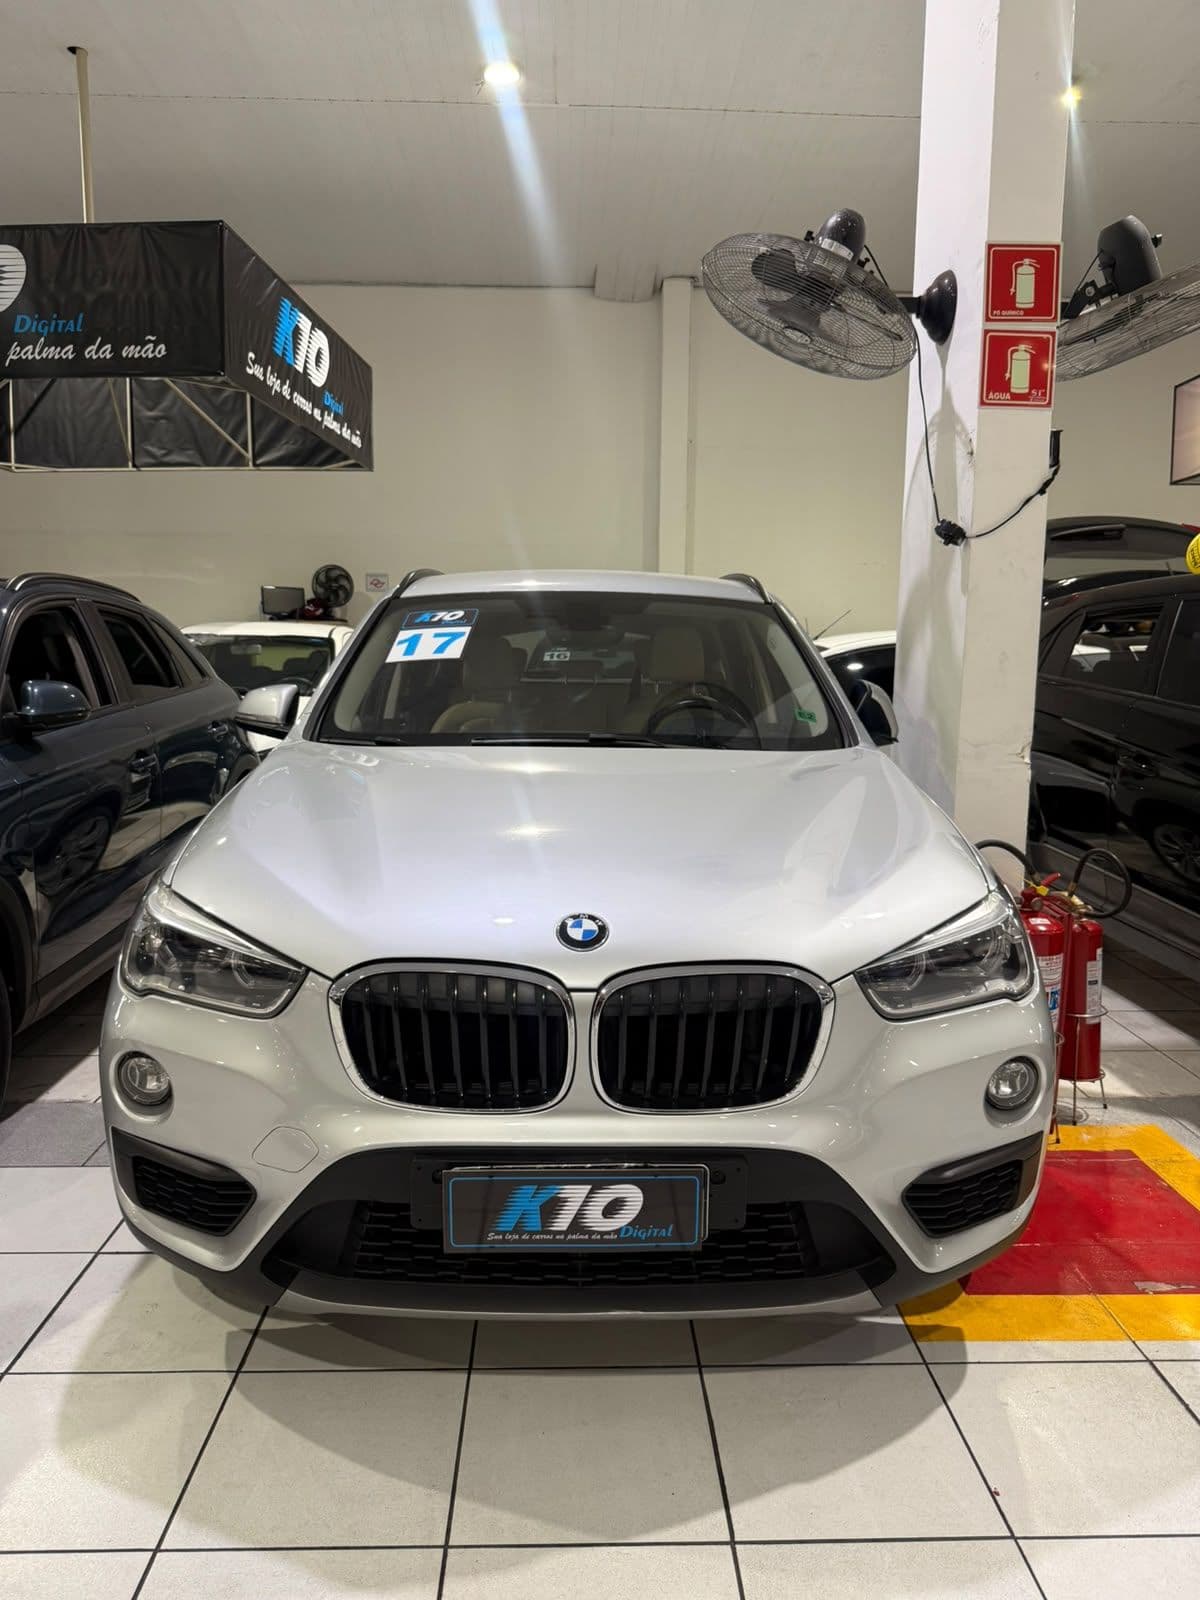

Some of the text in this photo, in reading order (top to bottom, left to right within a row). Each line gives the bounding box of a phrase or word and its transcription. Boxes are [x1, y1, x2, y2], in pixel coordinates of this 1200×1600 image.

[5, 335, 167, 367] palma da mão
[272, 296, 330, 387] K10
[396, 632, 465, 656] 17
[492, 1184, 644, 1232] K10
